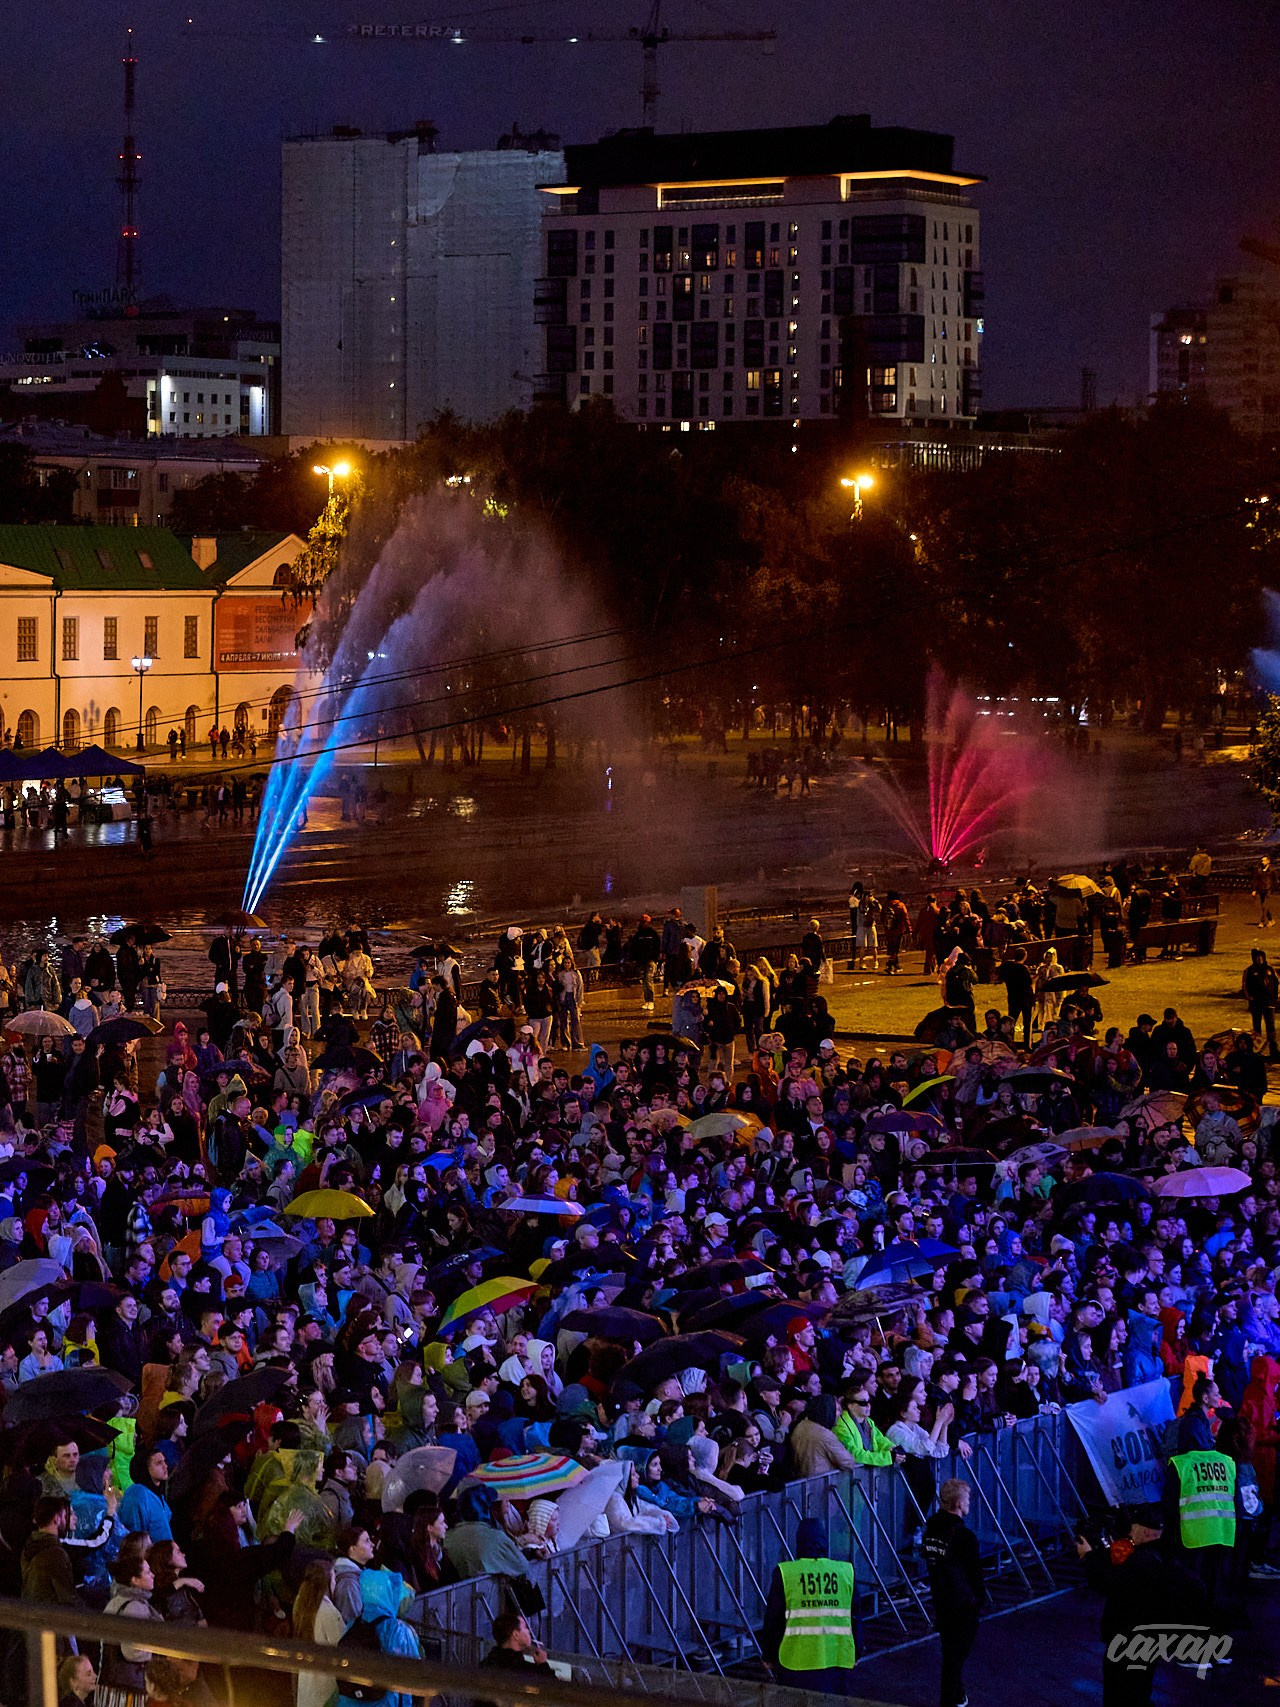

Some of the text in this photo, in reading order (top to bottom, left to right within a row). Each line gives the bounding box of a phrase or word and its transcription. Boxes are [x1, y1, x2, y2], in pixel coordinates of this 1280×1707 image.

[226, 653, 251, 662] АПРЕЛЯ
[1193, 1462, 1227, 1482] 15069
[800, 1572, 838, 1595] 15126
[801, 1599, 839, 1607] STEWARD
